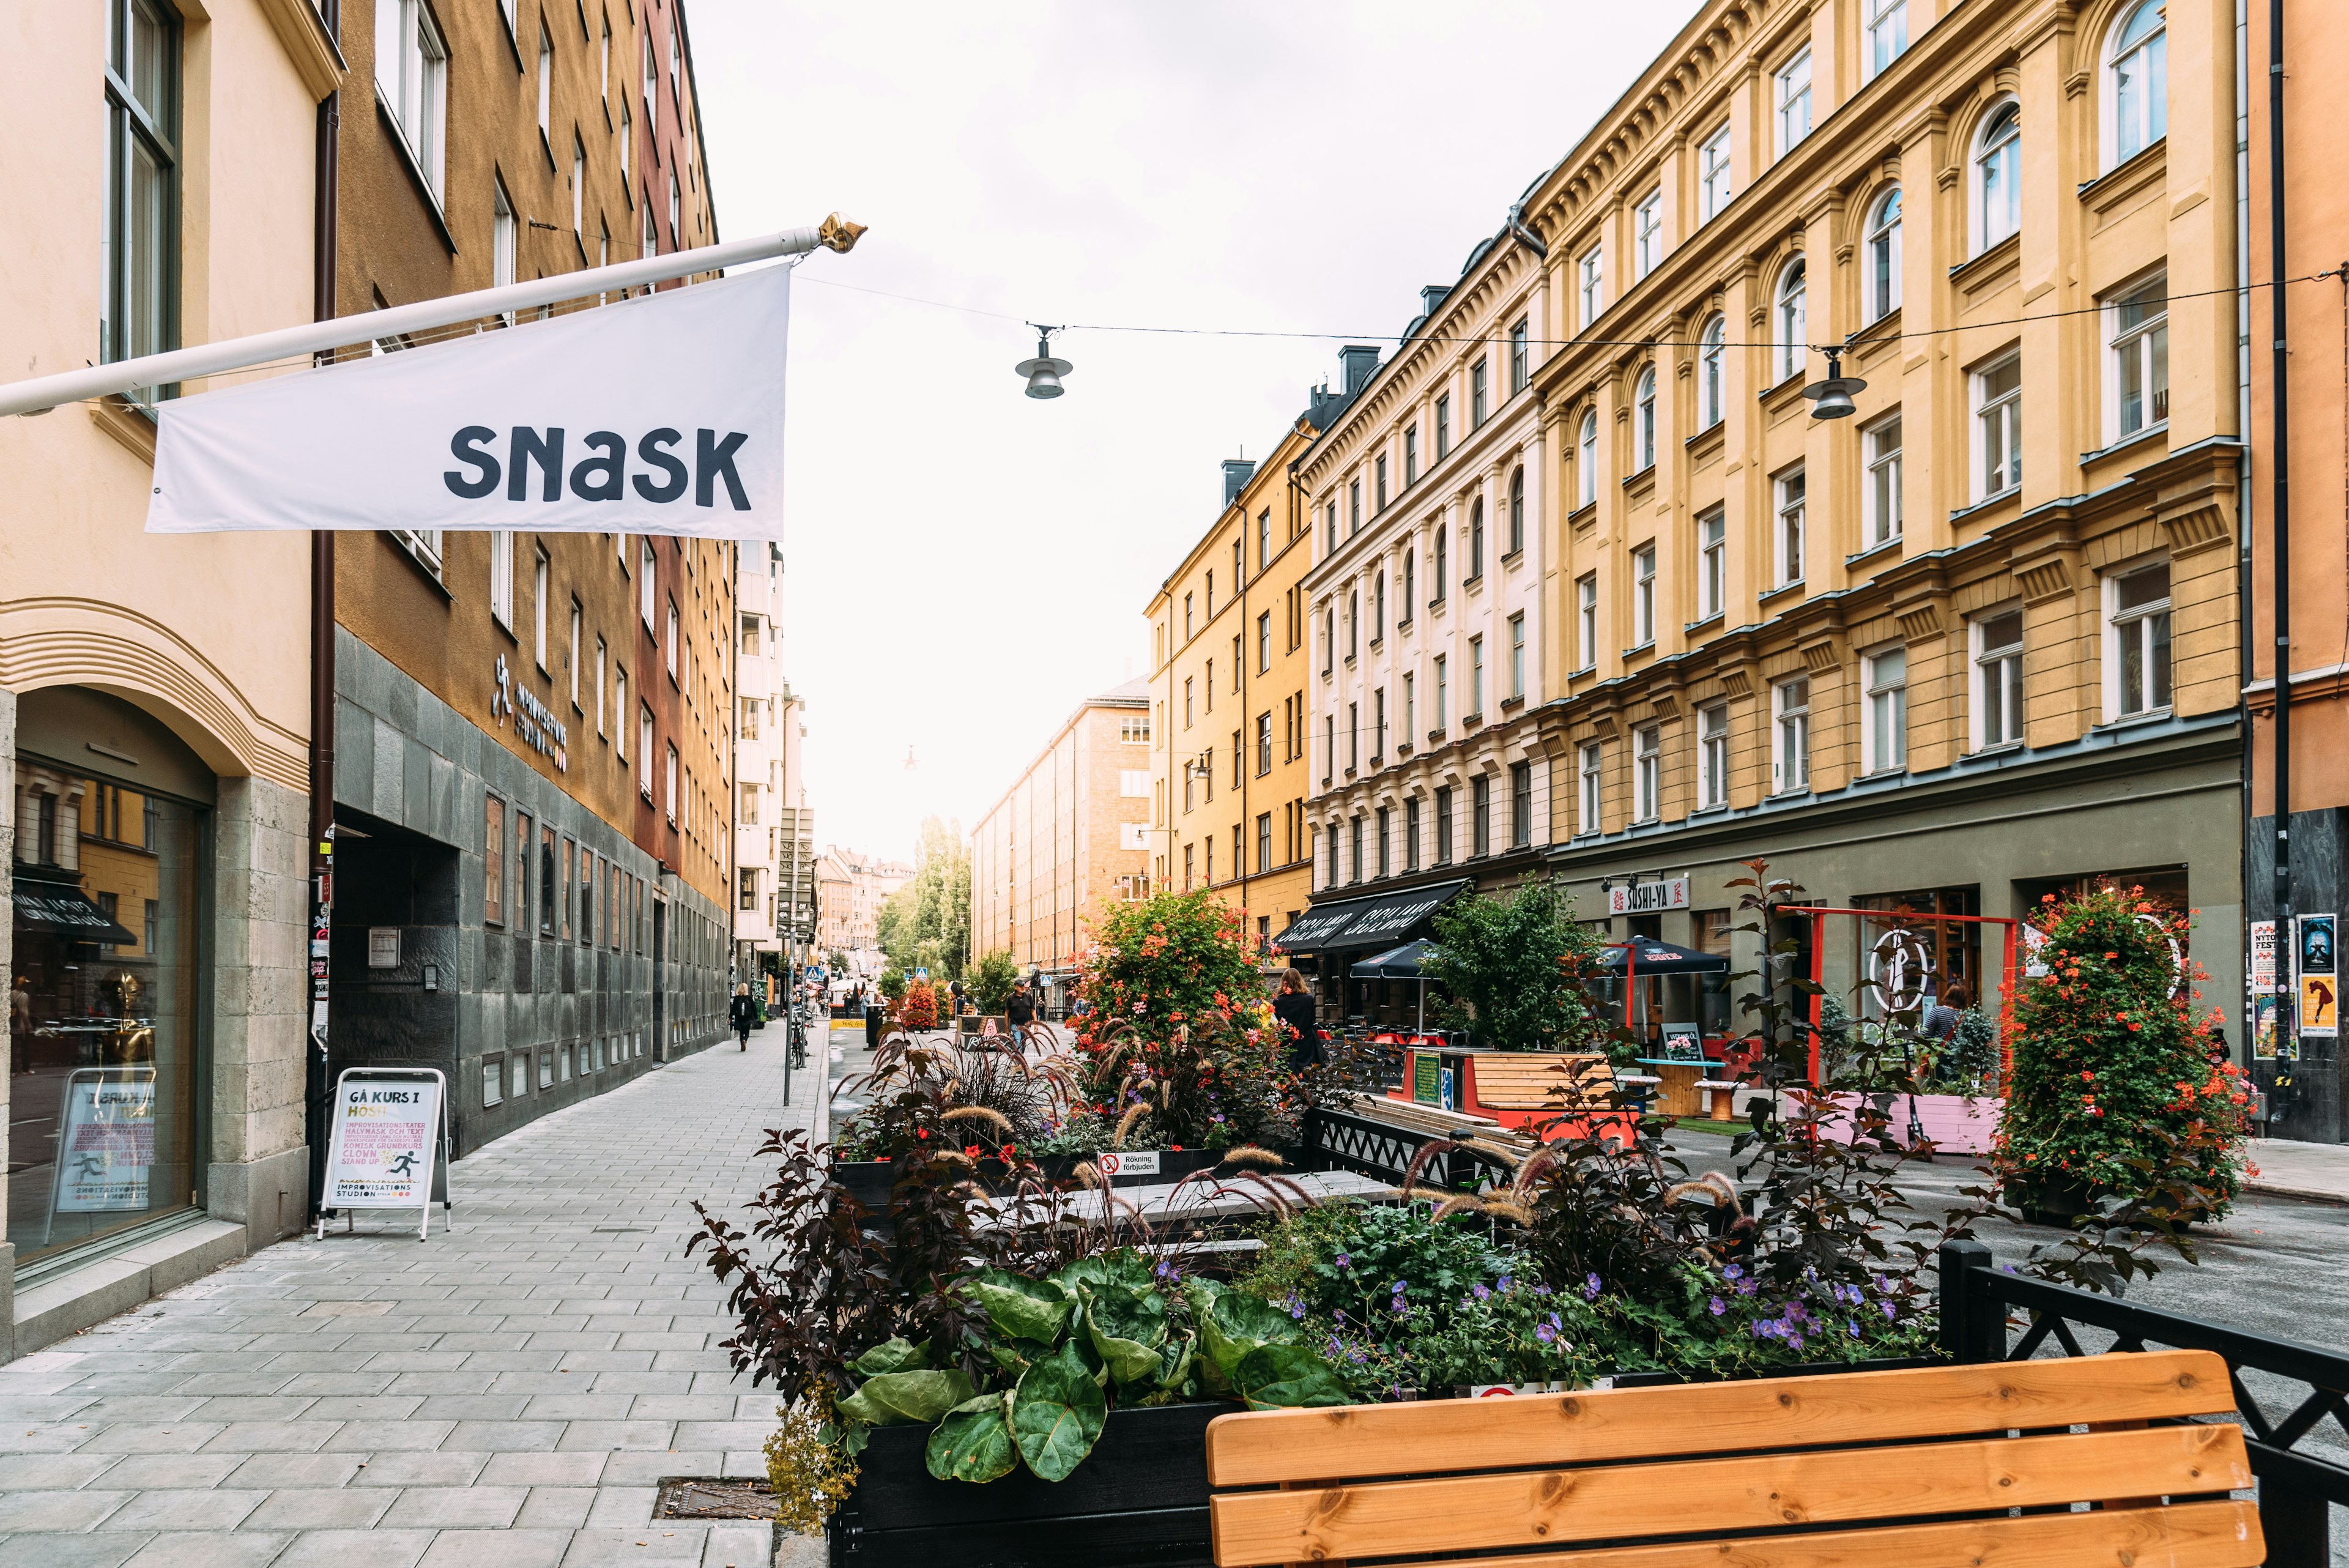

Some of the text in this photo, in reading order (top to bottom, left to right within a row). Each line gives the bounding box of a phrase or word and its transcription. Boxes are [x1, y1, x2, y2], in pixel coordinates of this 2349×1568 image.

[1627, 885, 1668, 910] SUSHI-YA
[350, 1089, 420, 1103] GÅ KURS I
[347, 1104, 386, 1117] HÖST!
